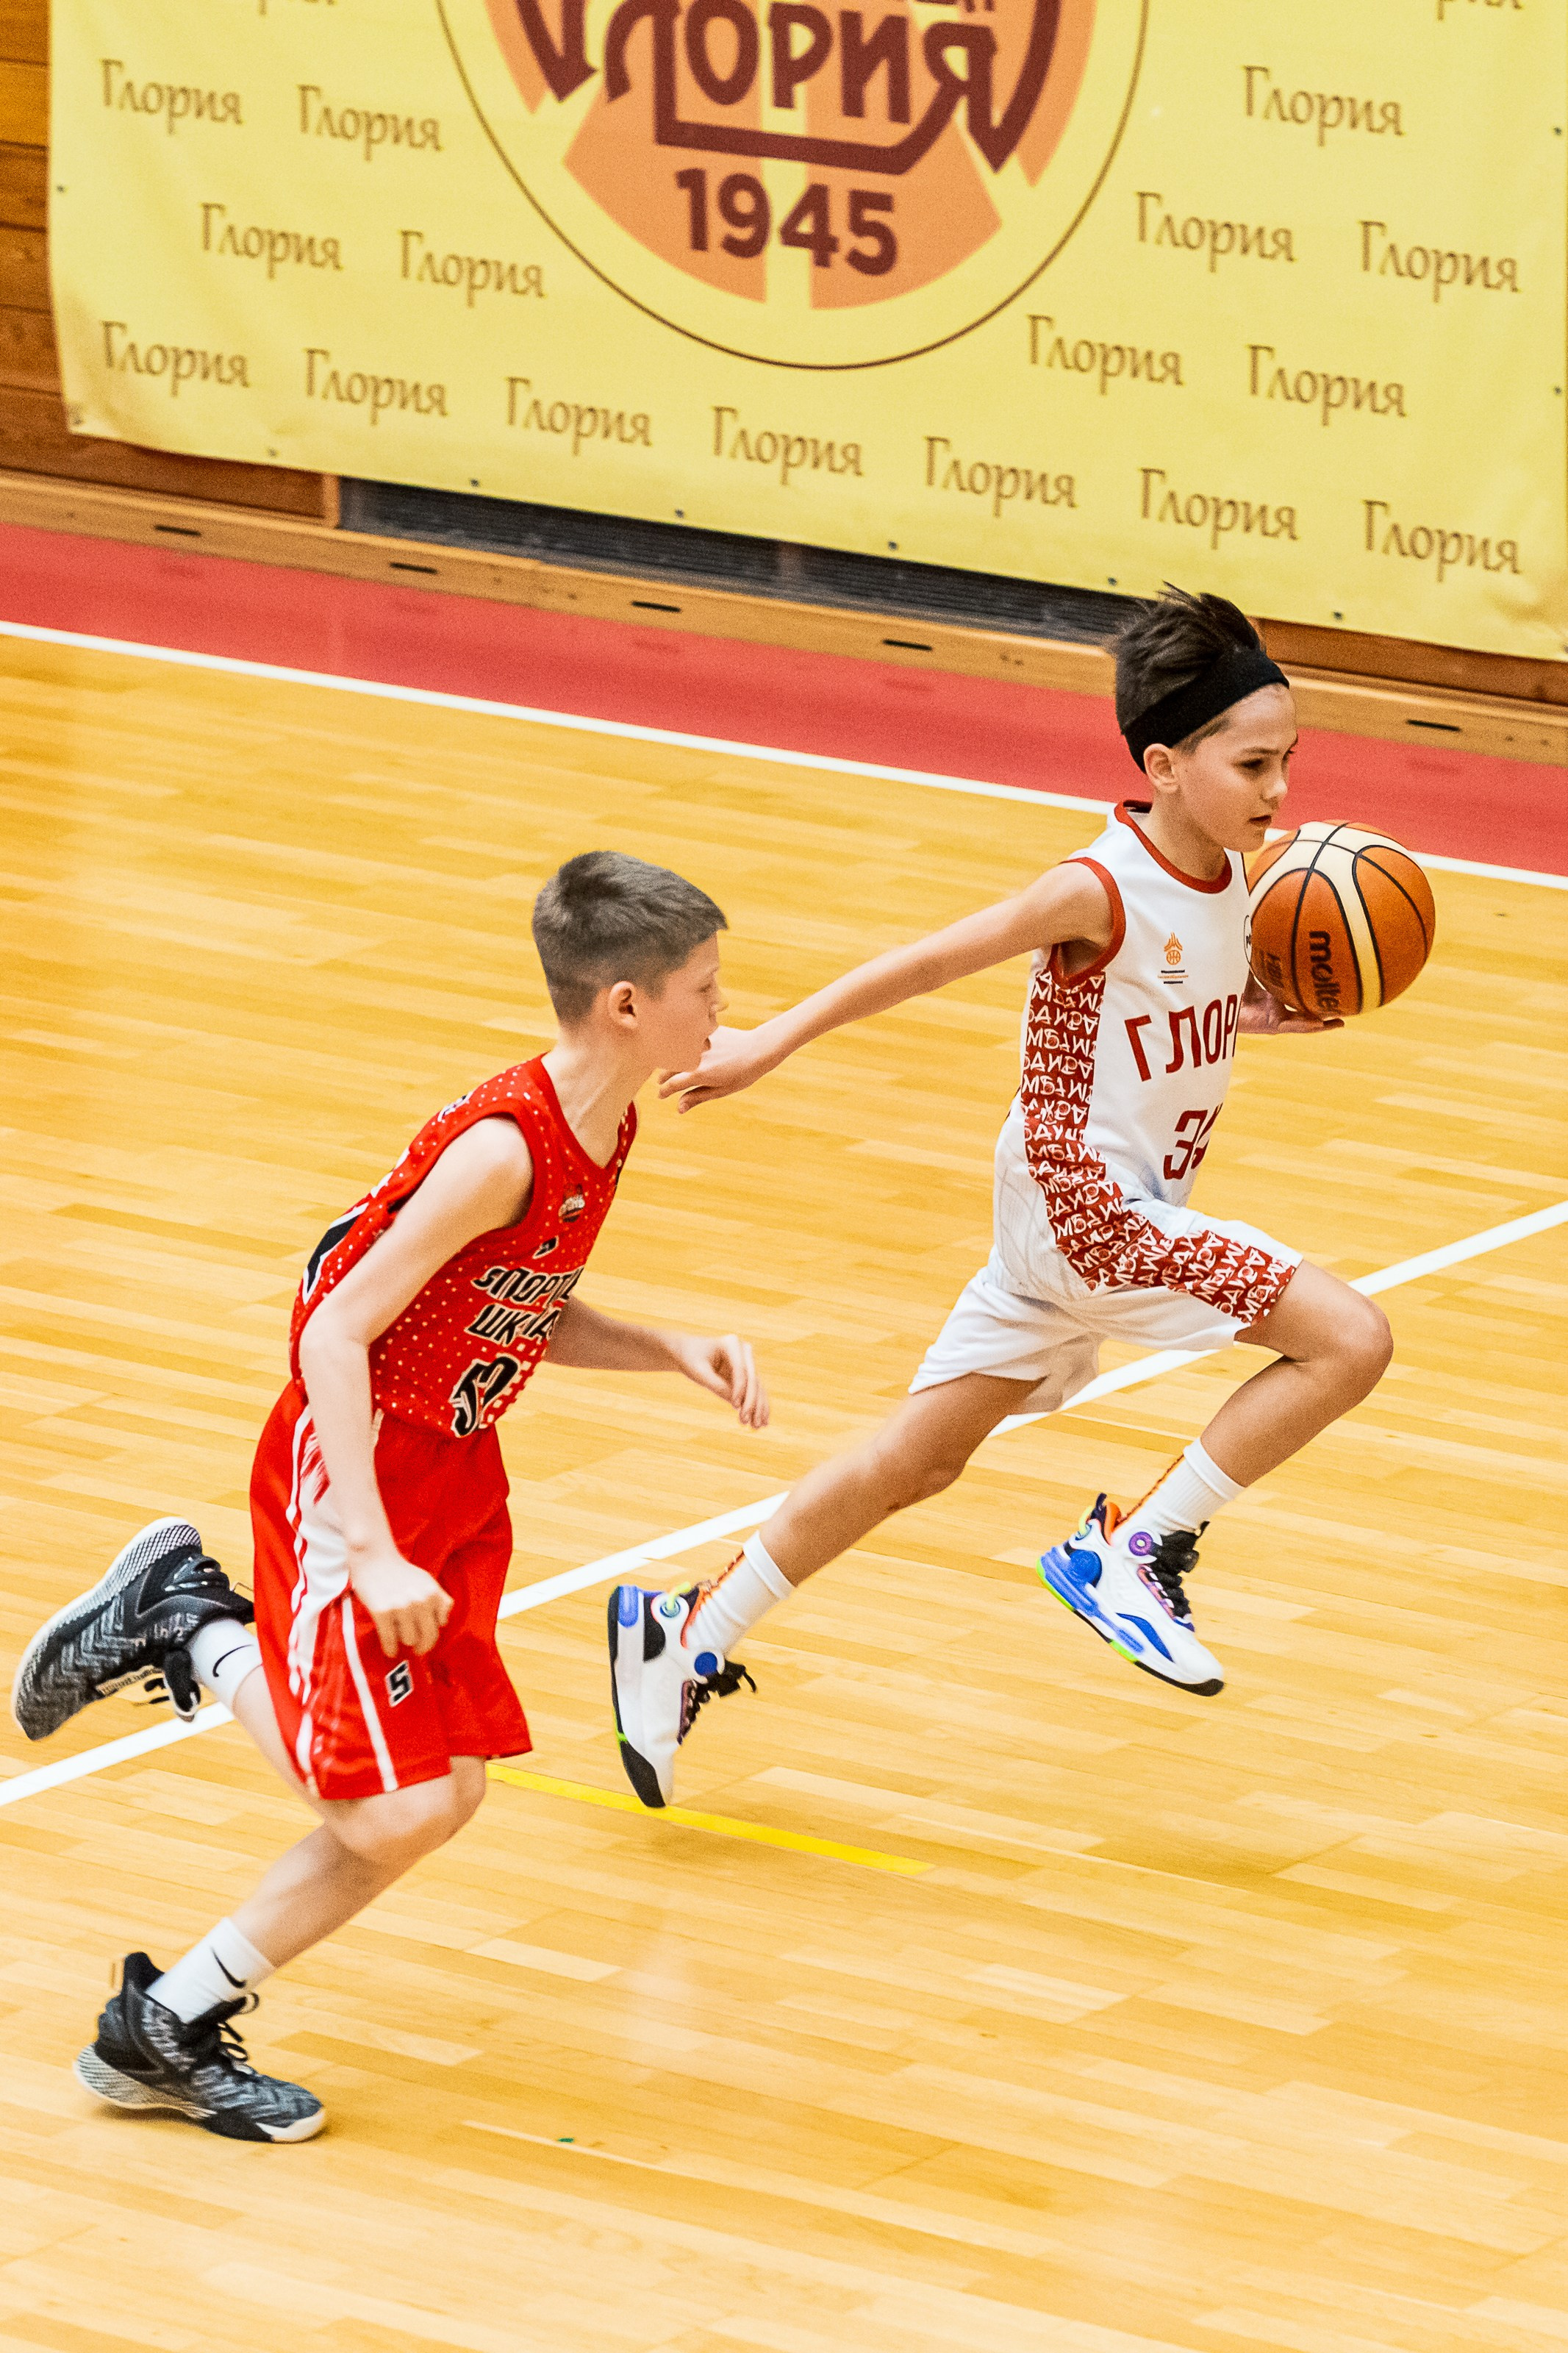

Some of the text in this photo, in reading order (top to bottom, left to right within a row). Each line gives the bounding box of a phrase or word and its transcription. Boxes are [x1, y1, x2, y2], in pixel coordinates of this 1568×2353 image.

[100, 58, 244, 135] Глория
[297, 84, 443, 161] Глория
[1242, 65, 1404, 147] Глория
[201, 202, 343, 279] Глория
[674, 167, 899, 276] 1945
[1135, 191, 1297, 273] Глория
[1358, 221, 1521, 303] Глория
[398, 229, 546, 308] Глория
[101, 321, 251, 396] Глория
[305, 348, 448, 426] Глория
[1027, 314, 1184, 395] Глория
[1247, 344, 1407, 426] Глория
[505, 376, 653, 457] Глория
[712, 405, 864, 486] Глория
[924, 436, 1078, 518] Глория
[1139, 467, 1300, 550] Глория
[1363, 499, 1522, 582] Глория
[1124, 993, 1243, 1082] ГЛОР
